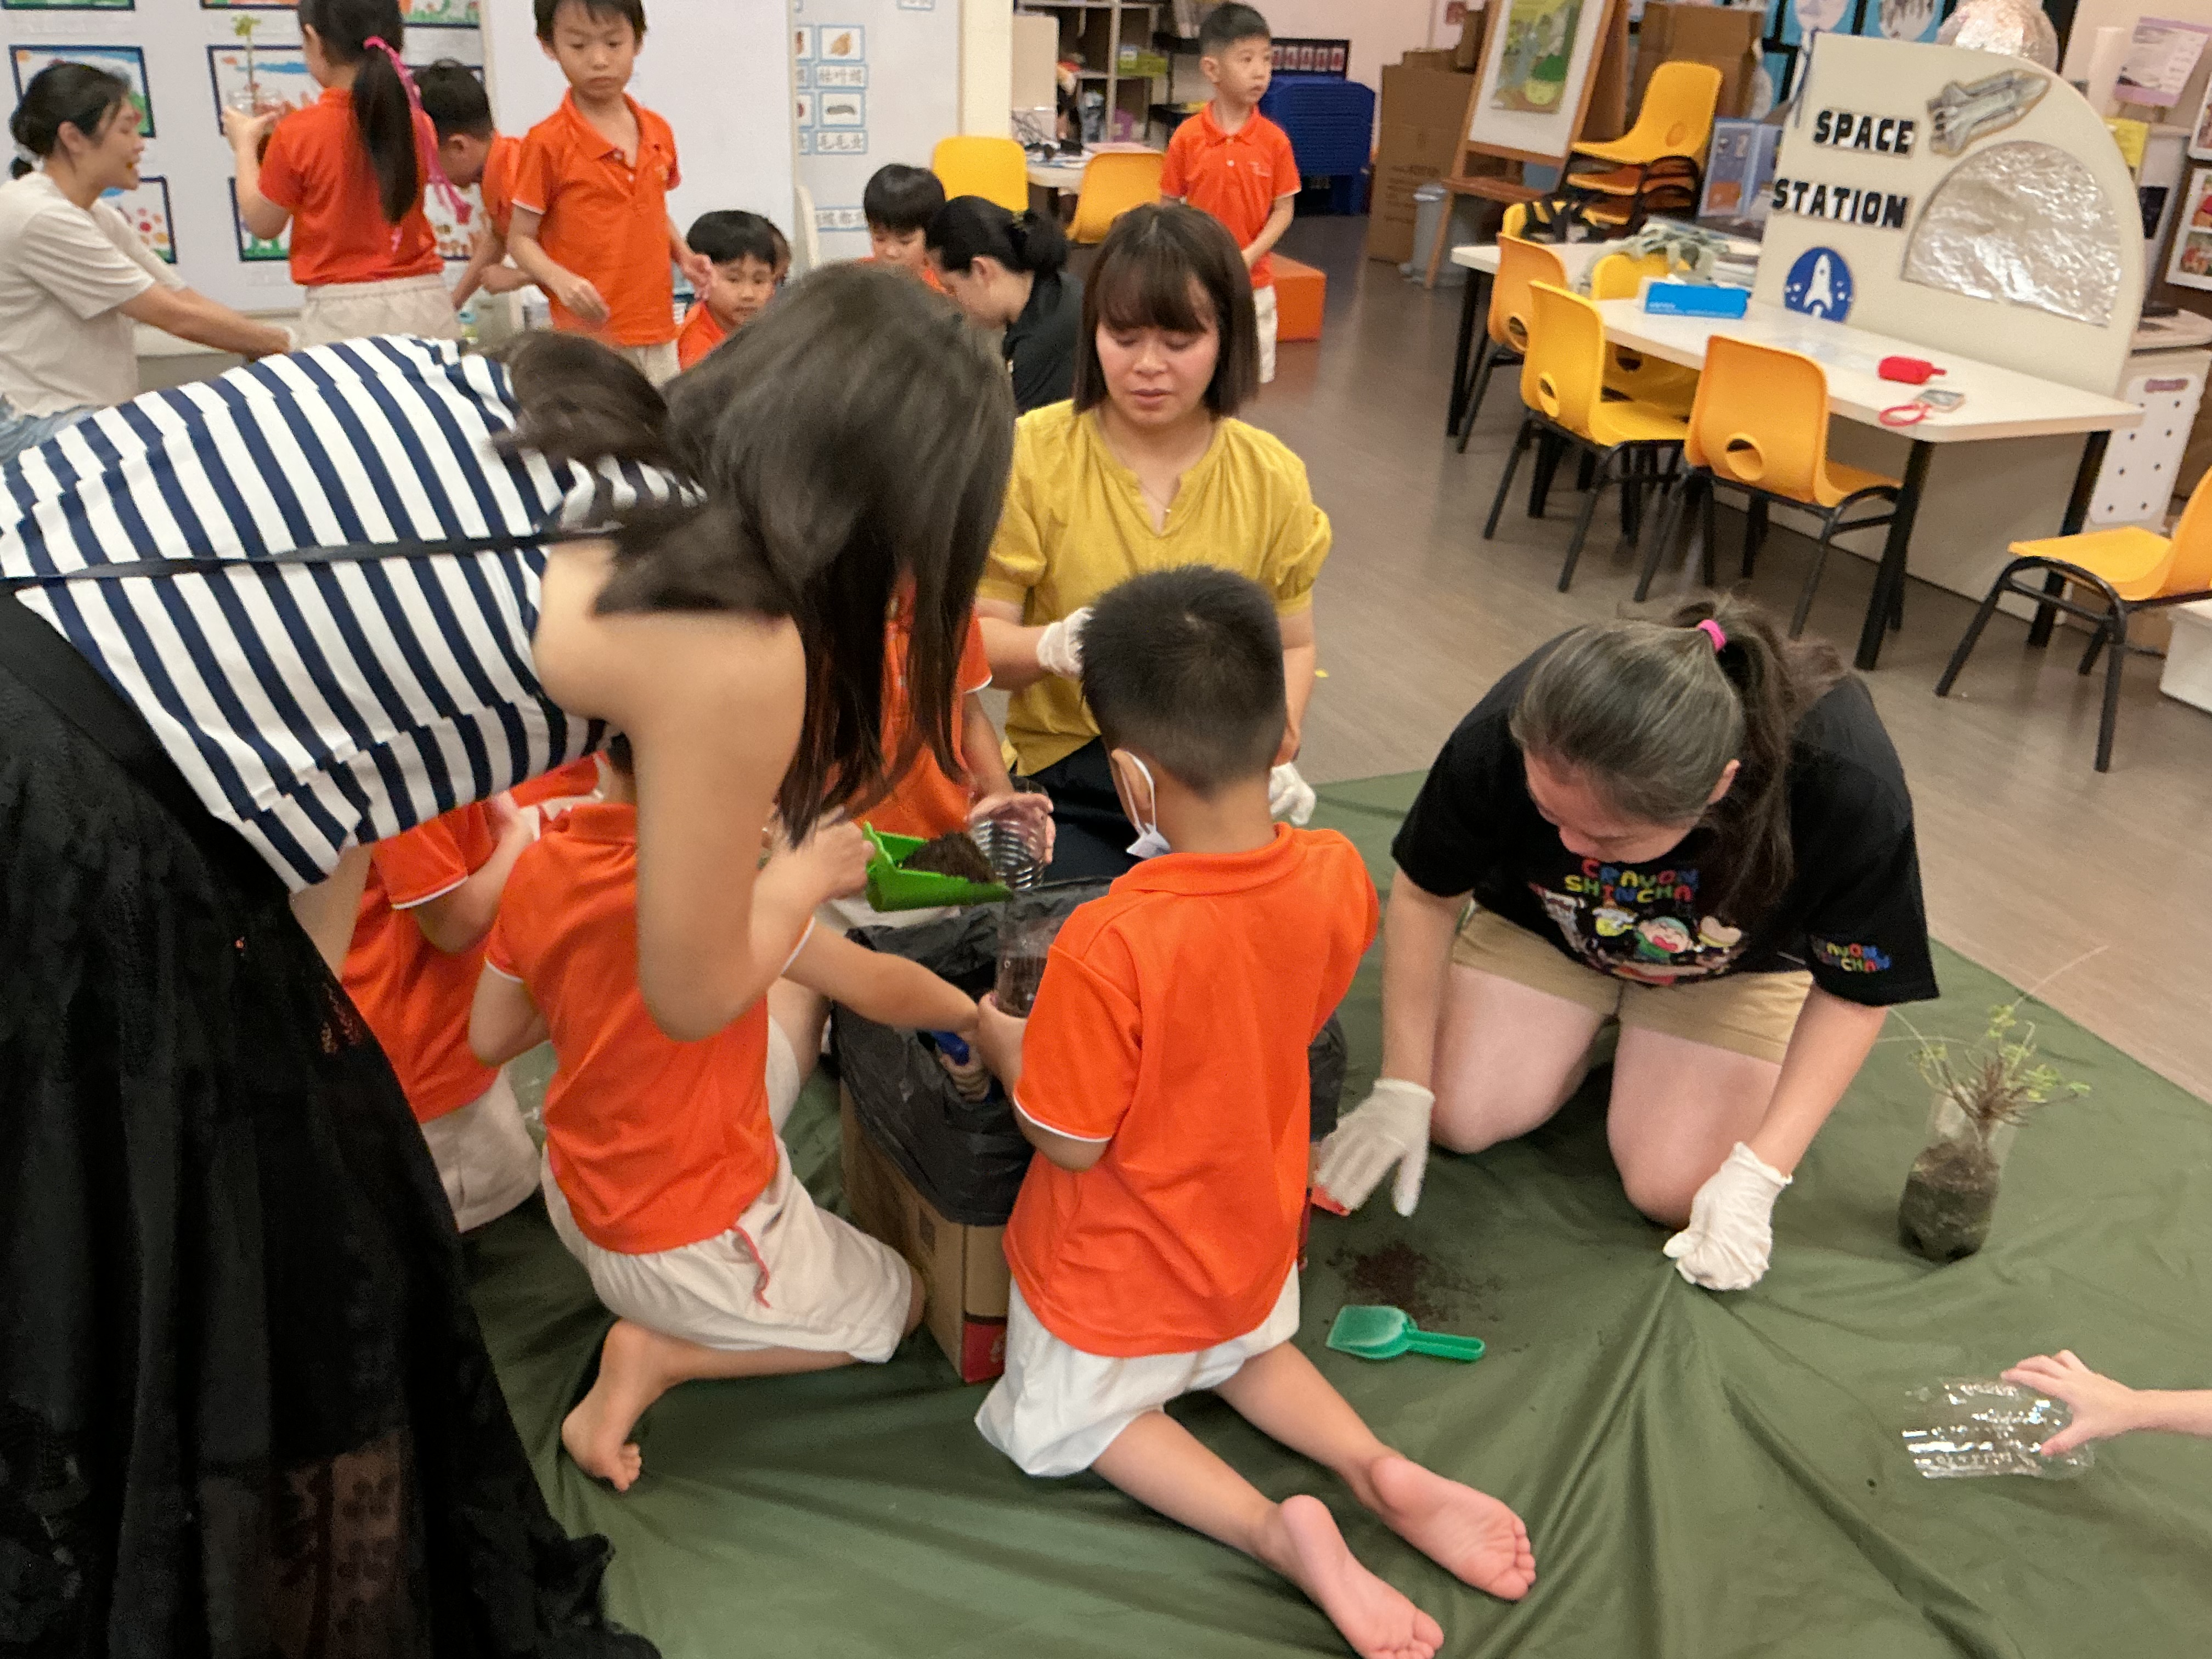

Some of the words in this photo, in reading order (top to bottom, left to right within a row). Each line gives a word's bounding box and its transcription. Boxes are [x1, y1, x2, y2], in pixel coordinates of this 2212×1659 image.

[1813, 110, 1914, 154] SPACE
[1772, 178, 1908, 228] STATION
[1565, 874, 1700, 903] SHINCHA
